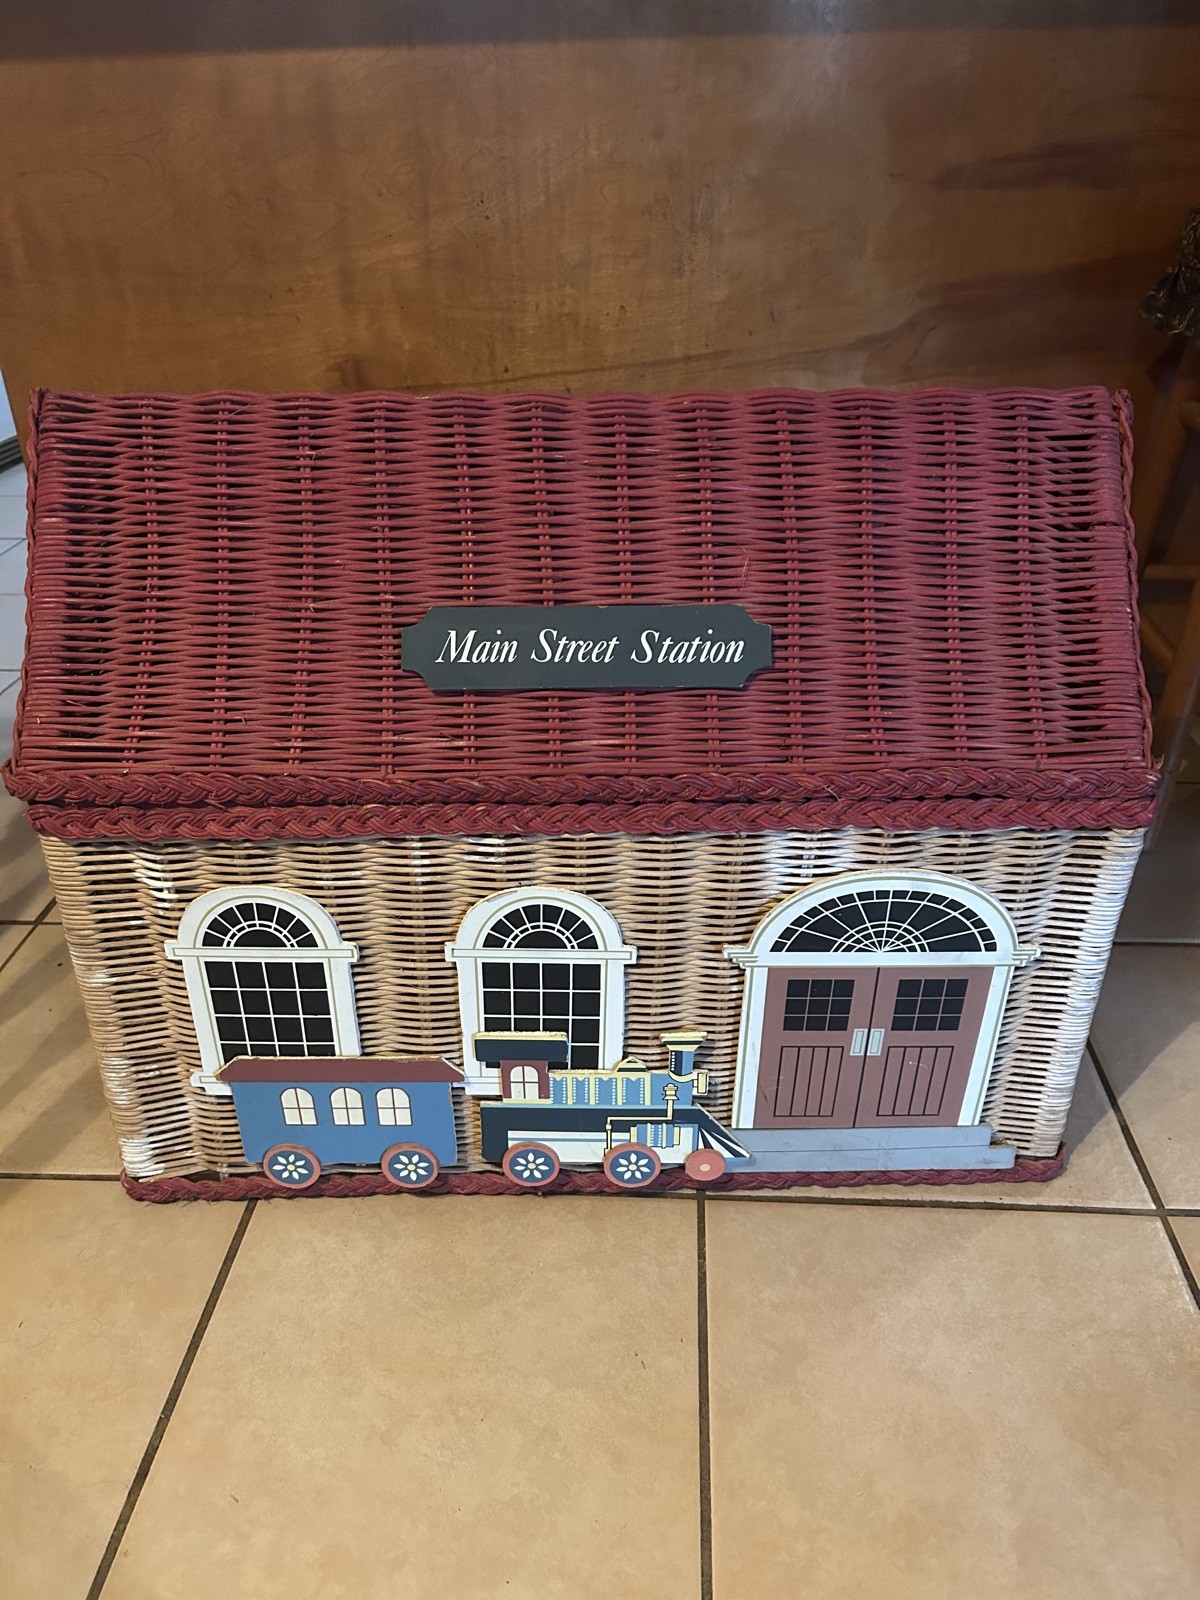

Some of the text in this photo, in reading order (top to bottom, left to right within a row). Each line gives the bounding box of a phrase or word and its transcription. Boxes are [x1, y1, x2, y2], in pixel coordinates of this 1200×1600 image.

[434, 628, 745, 664] Main Street Station
